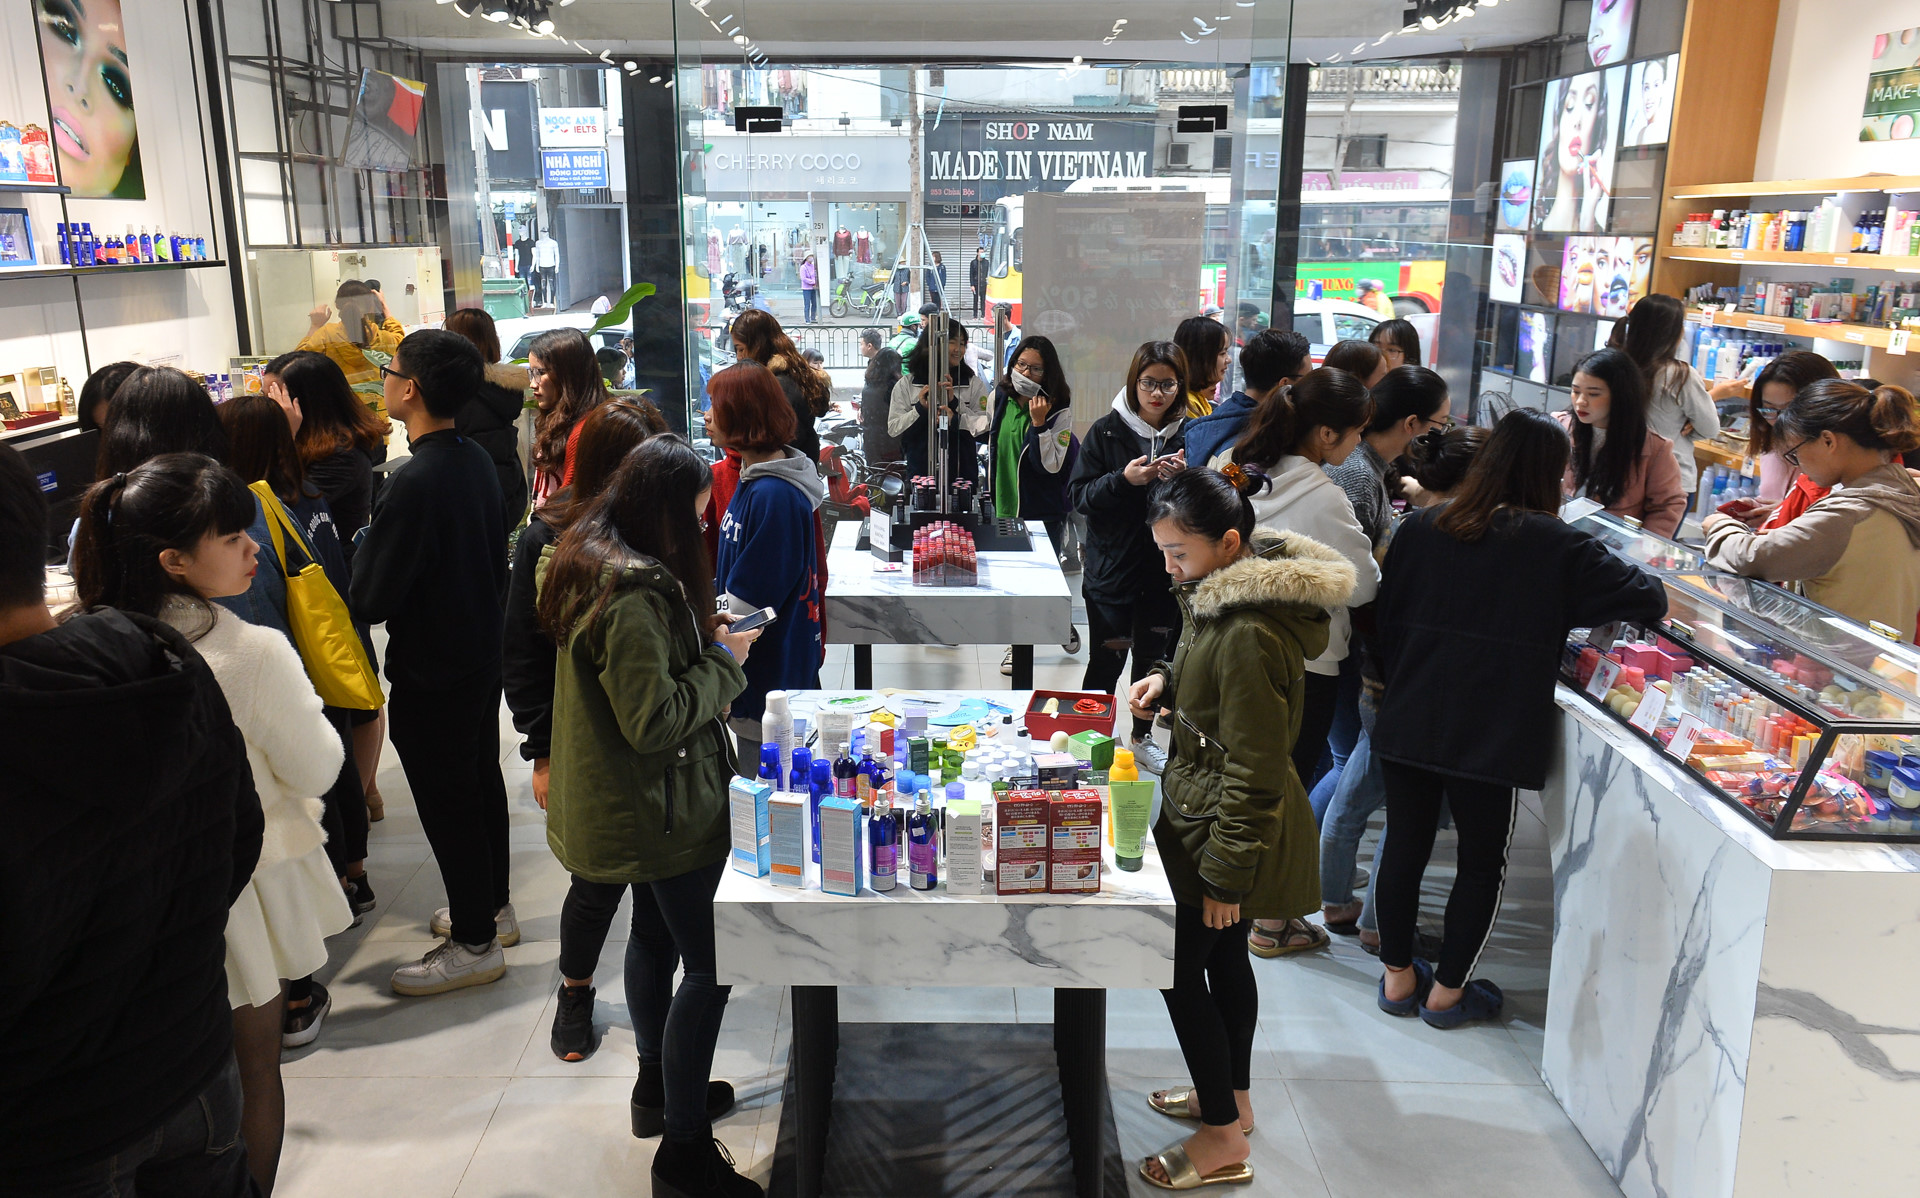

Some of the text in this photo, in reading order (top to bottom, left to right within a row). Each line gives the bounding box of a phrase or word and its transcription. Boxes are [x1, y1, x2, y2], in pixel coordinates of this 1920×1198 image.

[1871, 83, 1920, 103] MAKE-
[573, 125, 598, 134] IELTS
[985, 122, 1094, 141] SHOP NAM
[545, 151, 602, 169] NHÀ NGHỈ
[714, 153, 862, 171] CHERRY COCO
[930, 150, 1147, 181] MADE IN VIETNAM
[813, 222, 824, 230] 251
